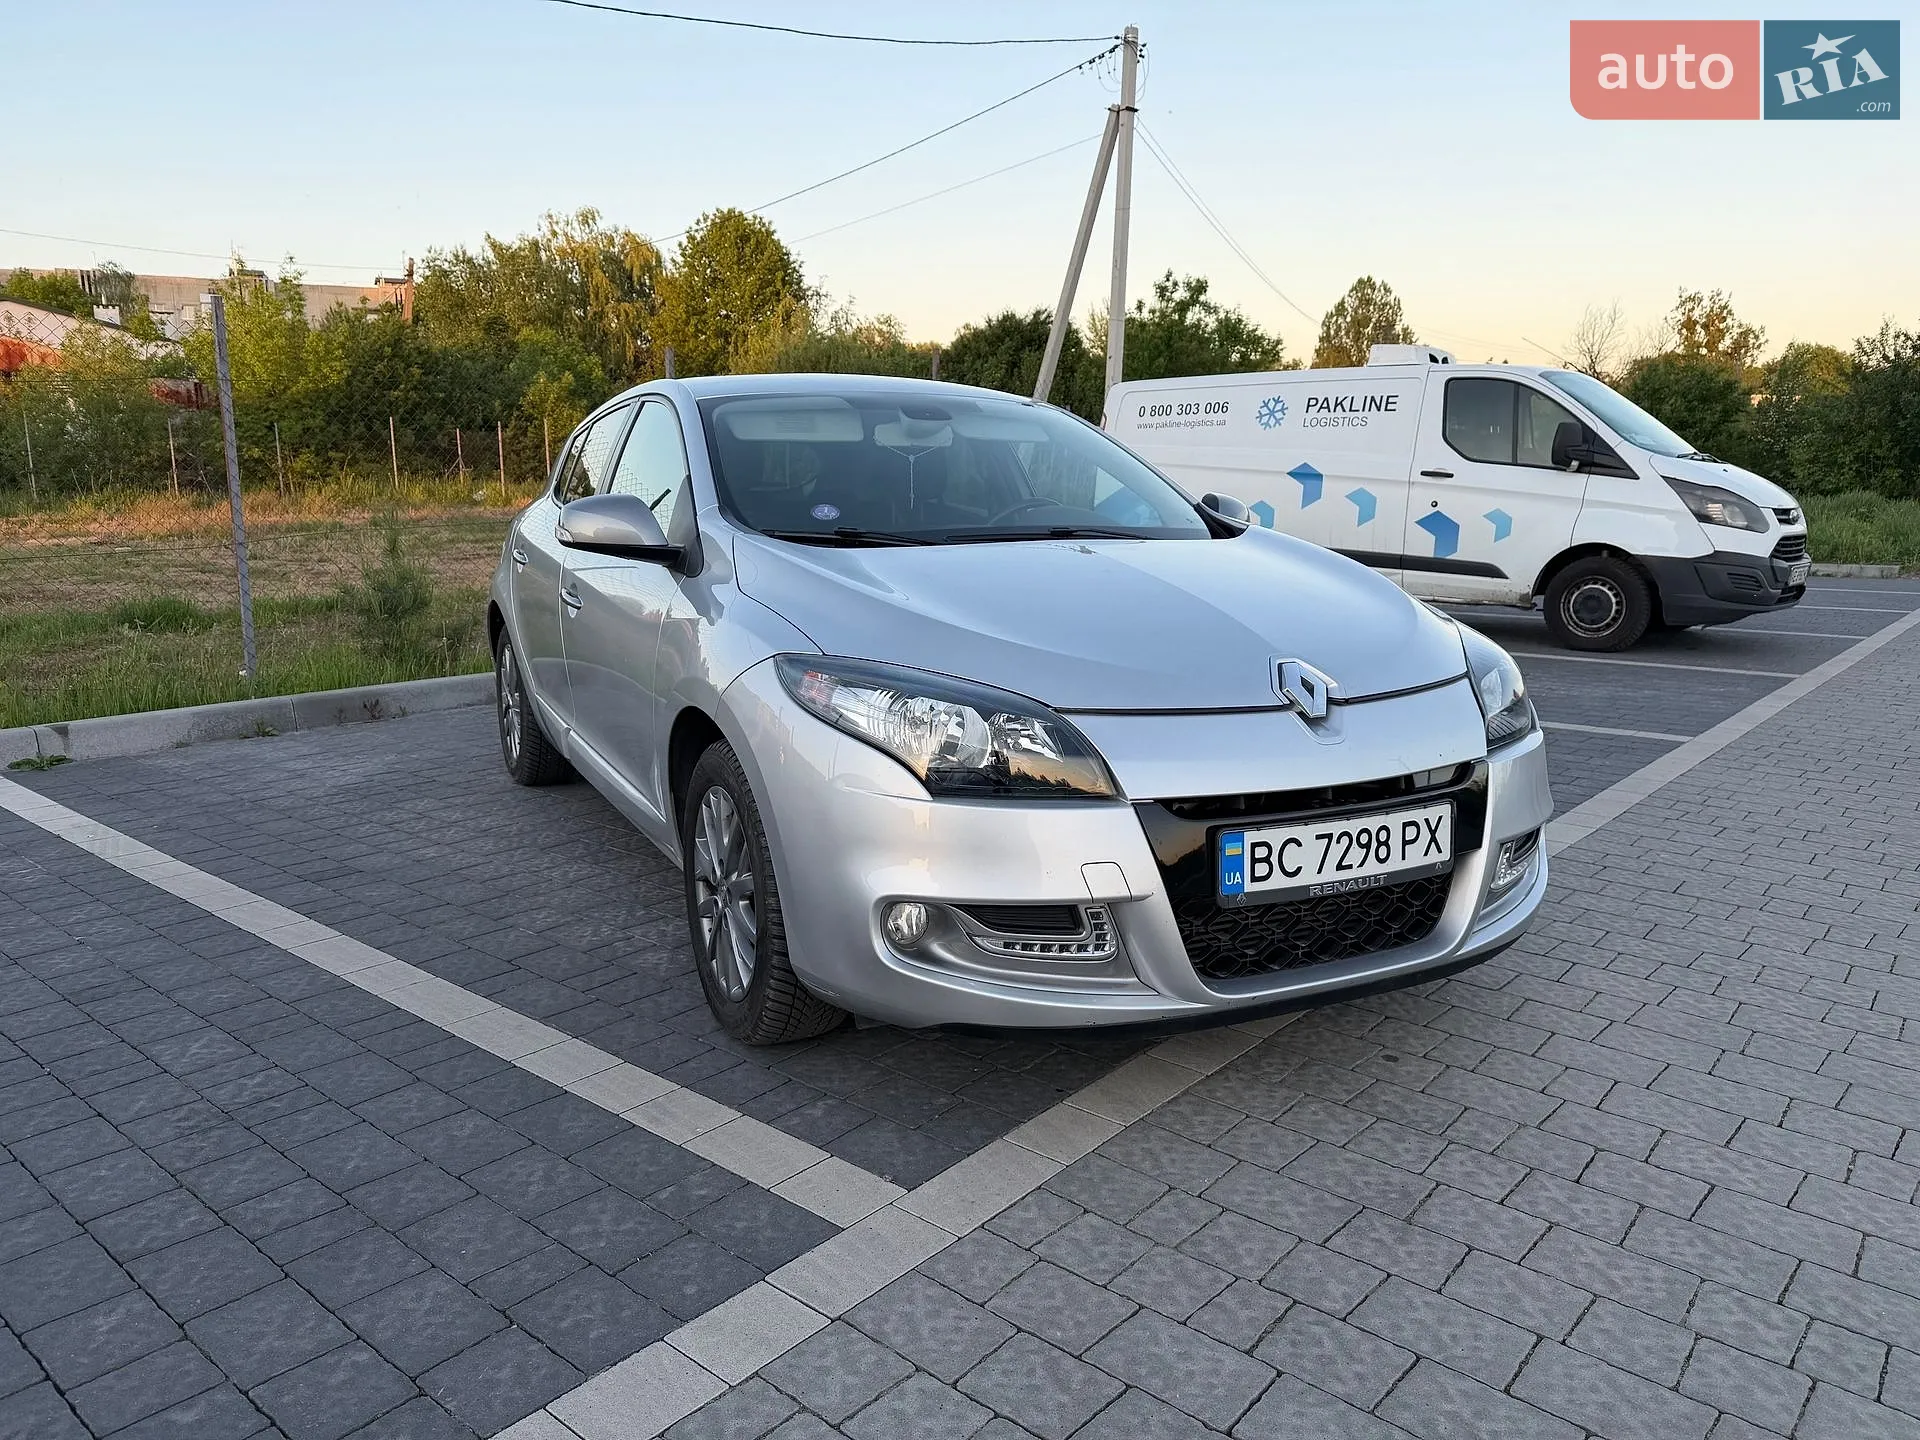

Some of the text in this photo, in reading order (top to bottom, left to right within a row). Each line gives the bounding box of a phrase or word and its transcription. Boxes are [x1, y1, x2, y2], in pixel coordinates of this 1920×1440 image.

[1138, 401, 1230, 418] 0 800 303 006
[1305, 395, 1399, 414] PAKLINE
[1136, 419, 1226, 430] www.pakline-logistics.ua
[1302, 416, 1368, 428] LOGISTICS
[1249, 815, 1444, 884] BC 7298 PX
[1225, 871, 1242, 886] UA
[1308, 874, 1388, 897] RENAULT
